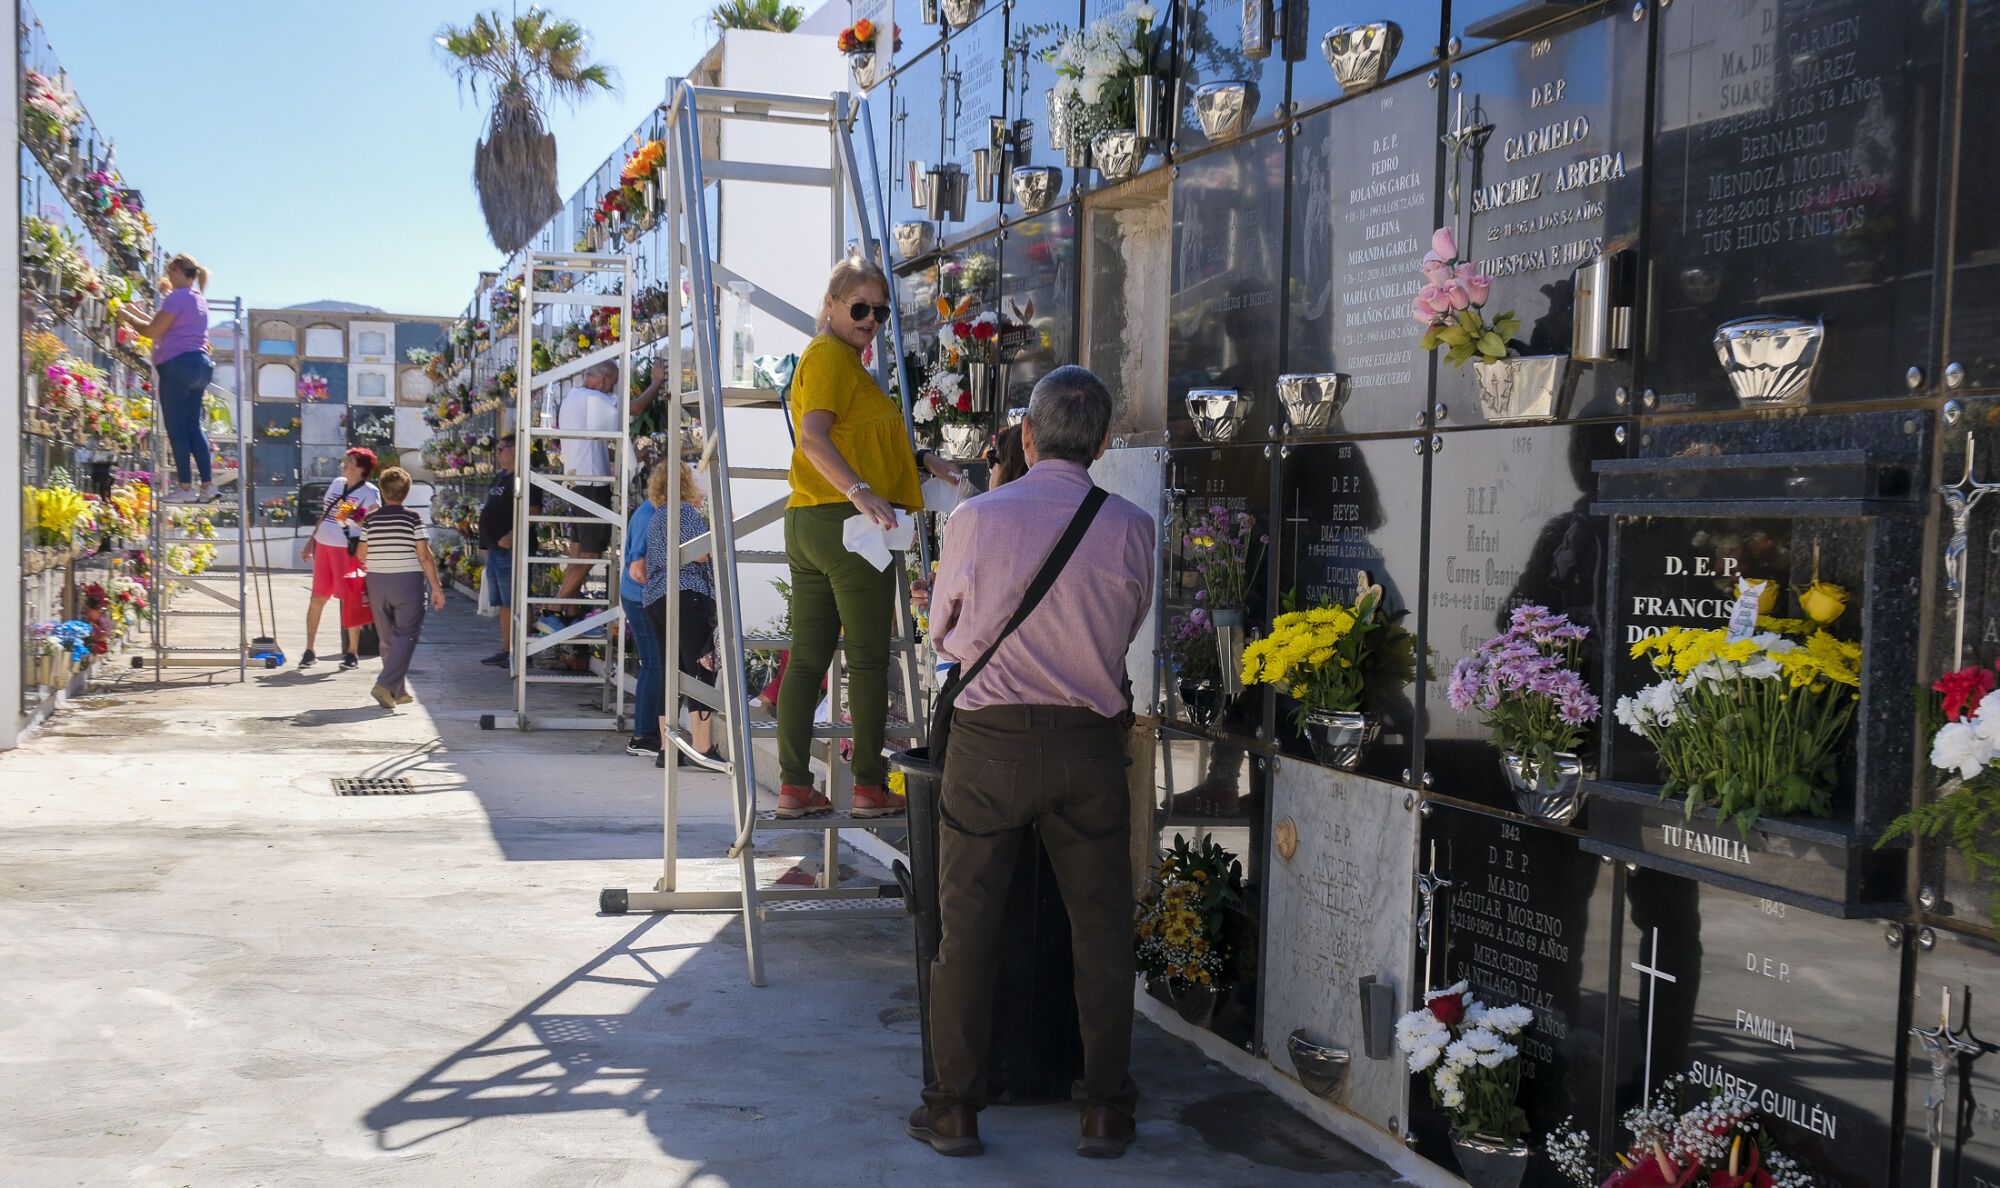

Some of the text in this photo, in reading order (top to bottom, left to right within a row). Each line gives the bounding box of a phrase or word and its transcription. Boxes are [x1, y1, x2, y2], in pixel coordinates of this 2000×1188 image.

[1788, 16, 1863, 57] CARMEN
[1839, 76, 1881, 106] AÑOS
[1504, 114, 1590, 163] CARMELO
[1740, 120, 1828, 163] BERNARDO
[1371, 155, 1399, 177] PEDRO
[1708, 148, 1864, 202] MENDOZA MOLINA
[1350, 168, 1421, 205] BOLAÑOS GARCÍA
[1471, 172, 1543, 214] SANCHEZ
[1774, 193, 1785, 214] A
[1788, 187, 1814, 211] LOS
[1539, 212, 1560, 230] LOS
[1576, 200, 1605, 222] AÑOS
[1365, 220, 1400, 241] DELFINA
[1702, 229, 1732, 256] TUS
[1736, 220, 1781, 250] HIJOS
[1787, 217, 1797, 241] Y
[1347, 233, 1418, 267] MIRANDA GARCÍA
[1550, 244, 1562, 266] E
[1563, 236, 1604, 265] HIJOS
[1342, 279, 1421, 308] MARÍA CANDELARIA
[1346, 299, 1416, 328] BOLAÑOS GARCÍA
[1347, 354, 1373, 370] SIEMPRE
[1332, 504, 1359, 521] REYES
[1320, 525, 1340, 542] DIAZ
[1466, 524, 1501, 553] Rafael
[1446, 555, 1481, 584] Torres
[1632, 596, 1735, 619] FRANCIS
[1500, 823, 1521, 842] 1842
[1661, 824, 1751, 865] TU FAMILIA
[1487, 873, 1530, 903] MARIO
[1507, 903, 1562, 938] MORENO
[1760, 897, 1785, 919] 1843
[1496, 924, 1505, 941] A
[1506, 927, 1526, 948] LOS
[1538, 938, 1569, 962] AÑOS
[1473, 942, 1539, 982] MERCEDES
[1457, 961, 1555, 1013] SANTIAGO DIAZ
[1536, 1015, 1567, 1040] AÑOS
[1735, 1008, 1796, 1050] FAMILIA
[1761, 1089, 1836, 1140] GUILLÉN
